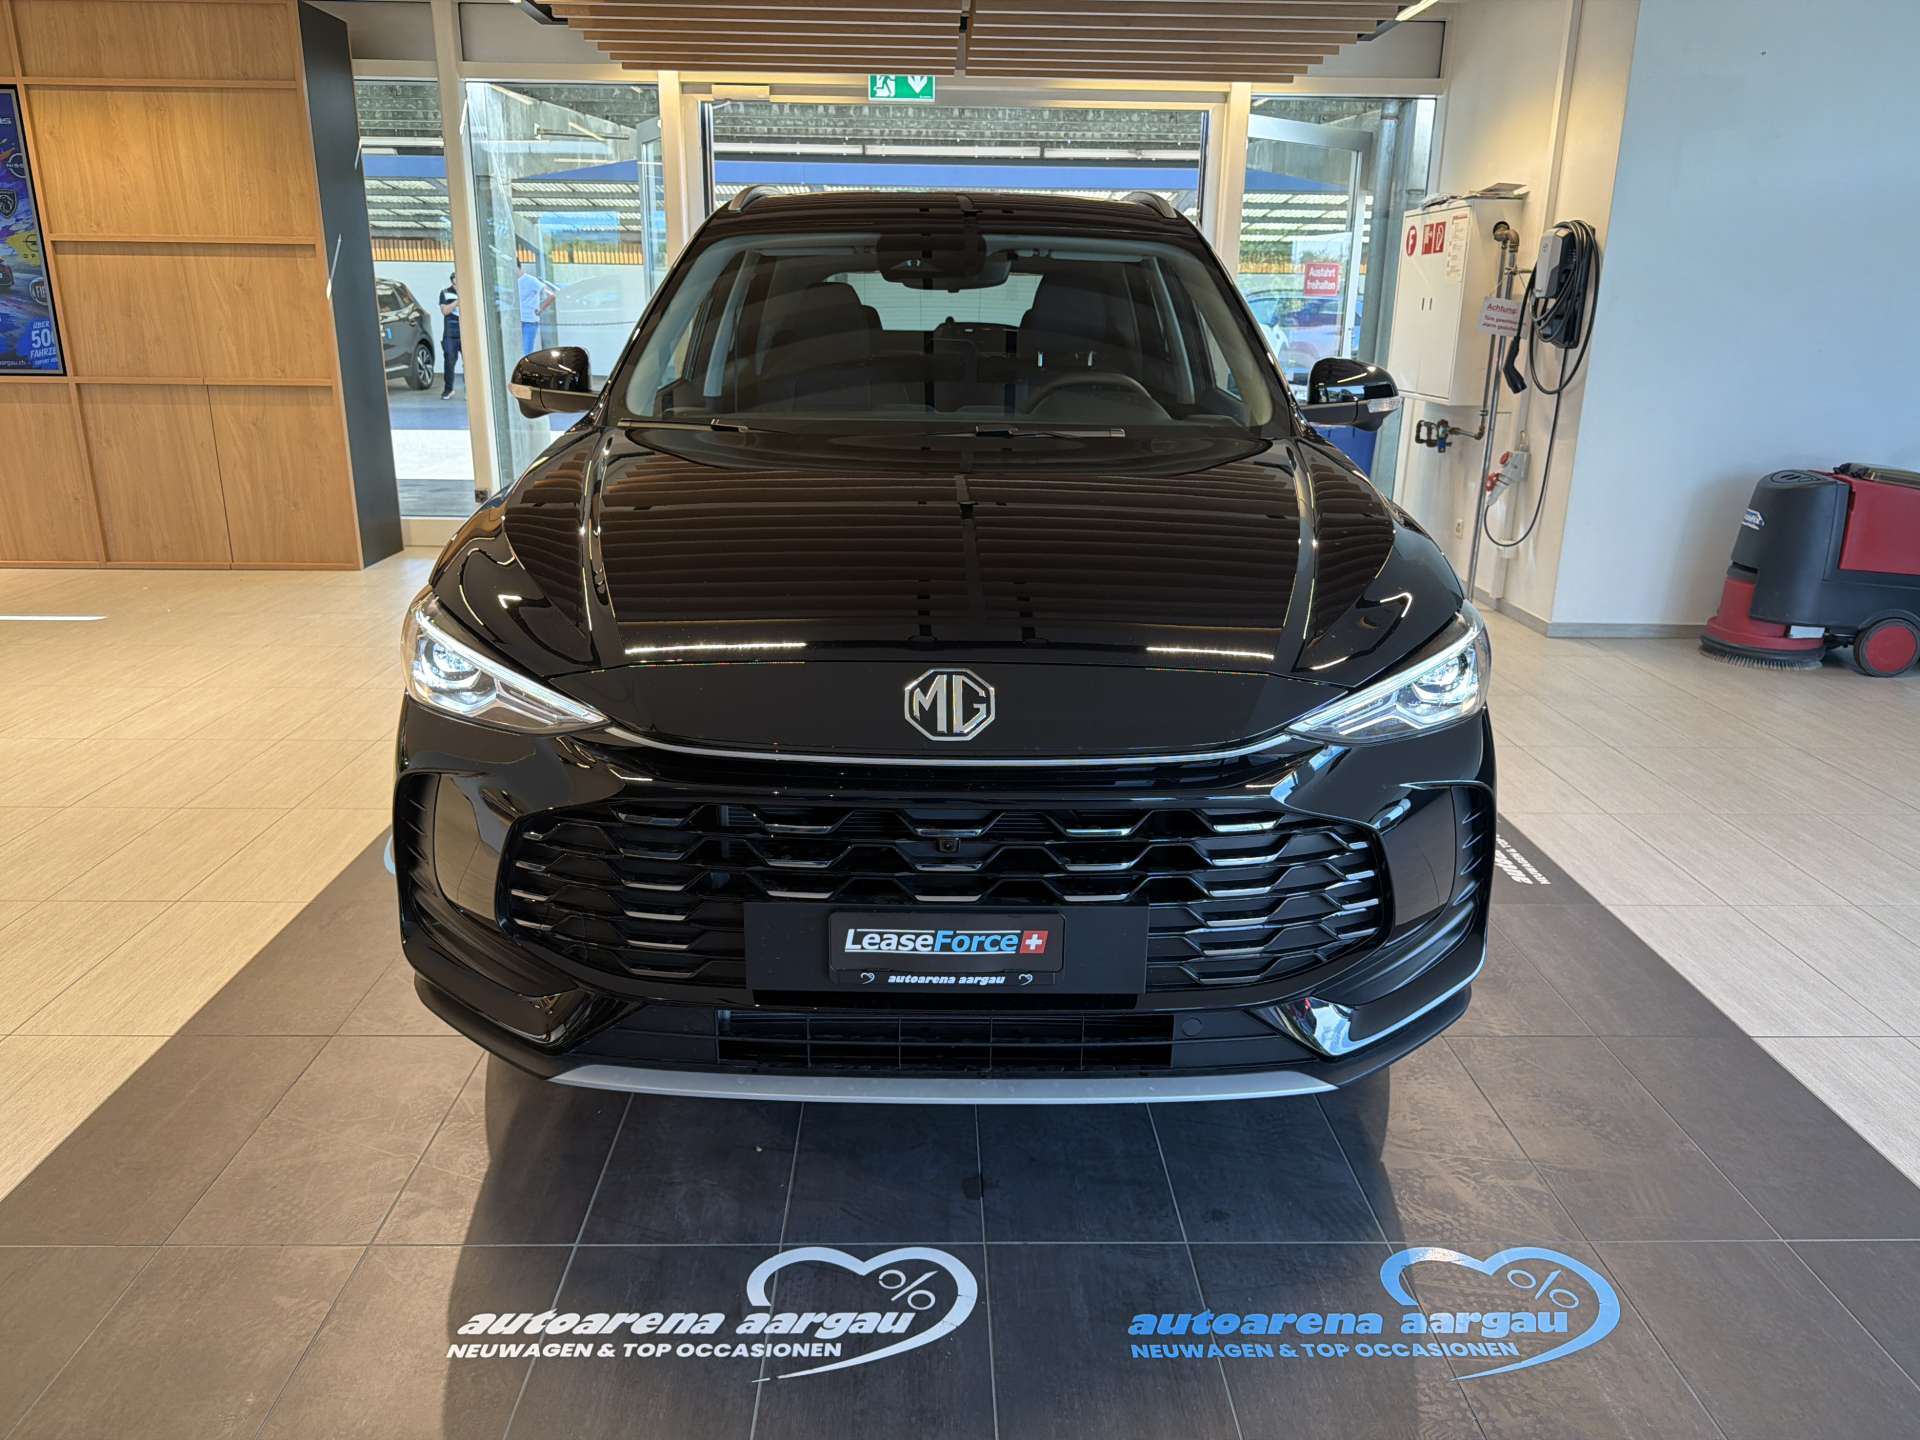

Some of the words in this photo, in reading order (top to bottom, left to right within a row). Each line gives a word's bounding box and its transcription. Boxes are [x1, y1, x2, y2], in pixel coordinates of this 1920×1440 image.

[913, 674, 987, 734] MG
[844, 928, 1020, 954] LeaseForce
[888, 974, 956, 986] autoarena
[958, 974, 1006, 987] aargau
[456, 1308, 726, 1335] autoarena
[735, 1312, 916, 1340] aargau
[1128, 1308, 1385, 1335] autoarena
[1400, 1311, 1568, 1339] aargau
[446, 1343, 594, 1359] NEUWAGEN
[597, 1343, 616, 1358] &
[623, 1343, 673, 1358] TOP
[675, 1343, 842, 1358] OCCASIONEN
[1131, 1343, 1275, 1359] NEUWAGEN
[1279, 1343, 1300, 1358] &
[1300, 1343, 1350, 1358] TOP
[1354, 1343, 1520, 1358] OCCASIONEN
